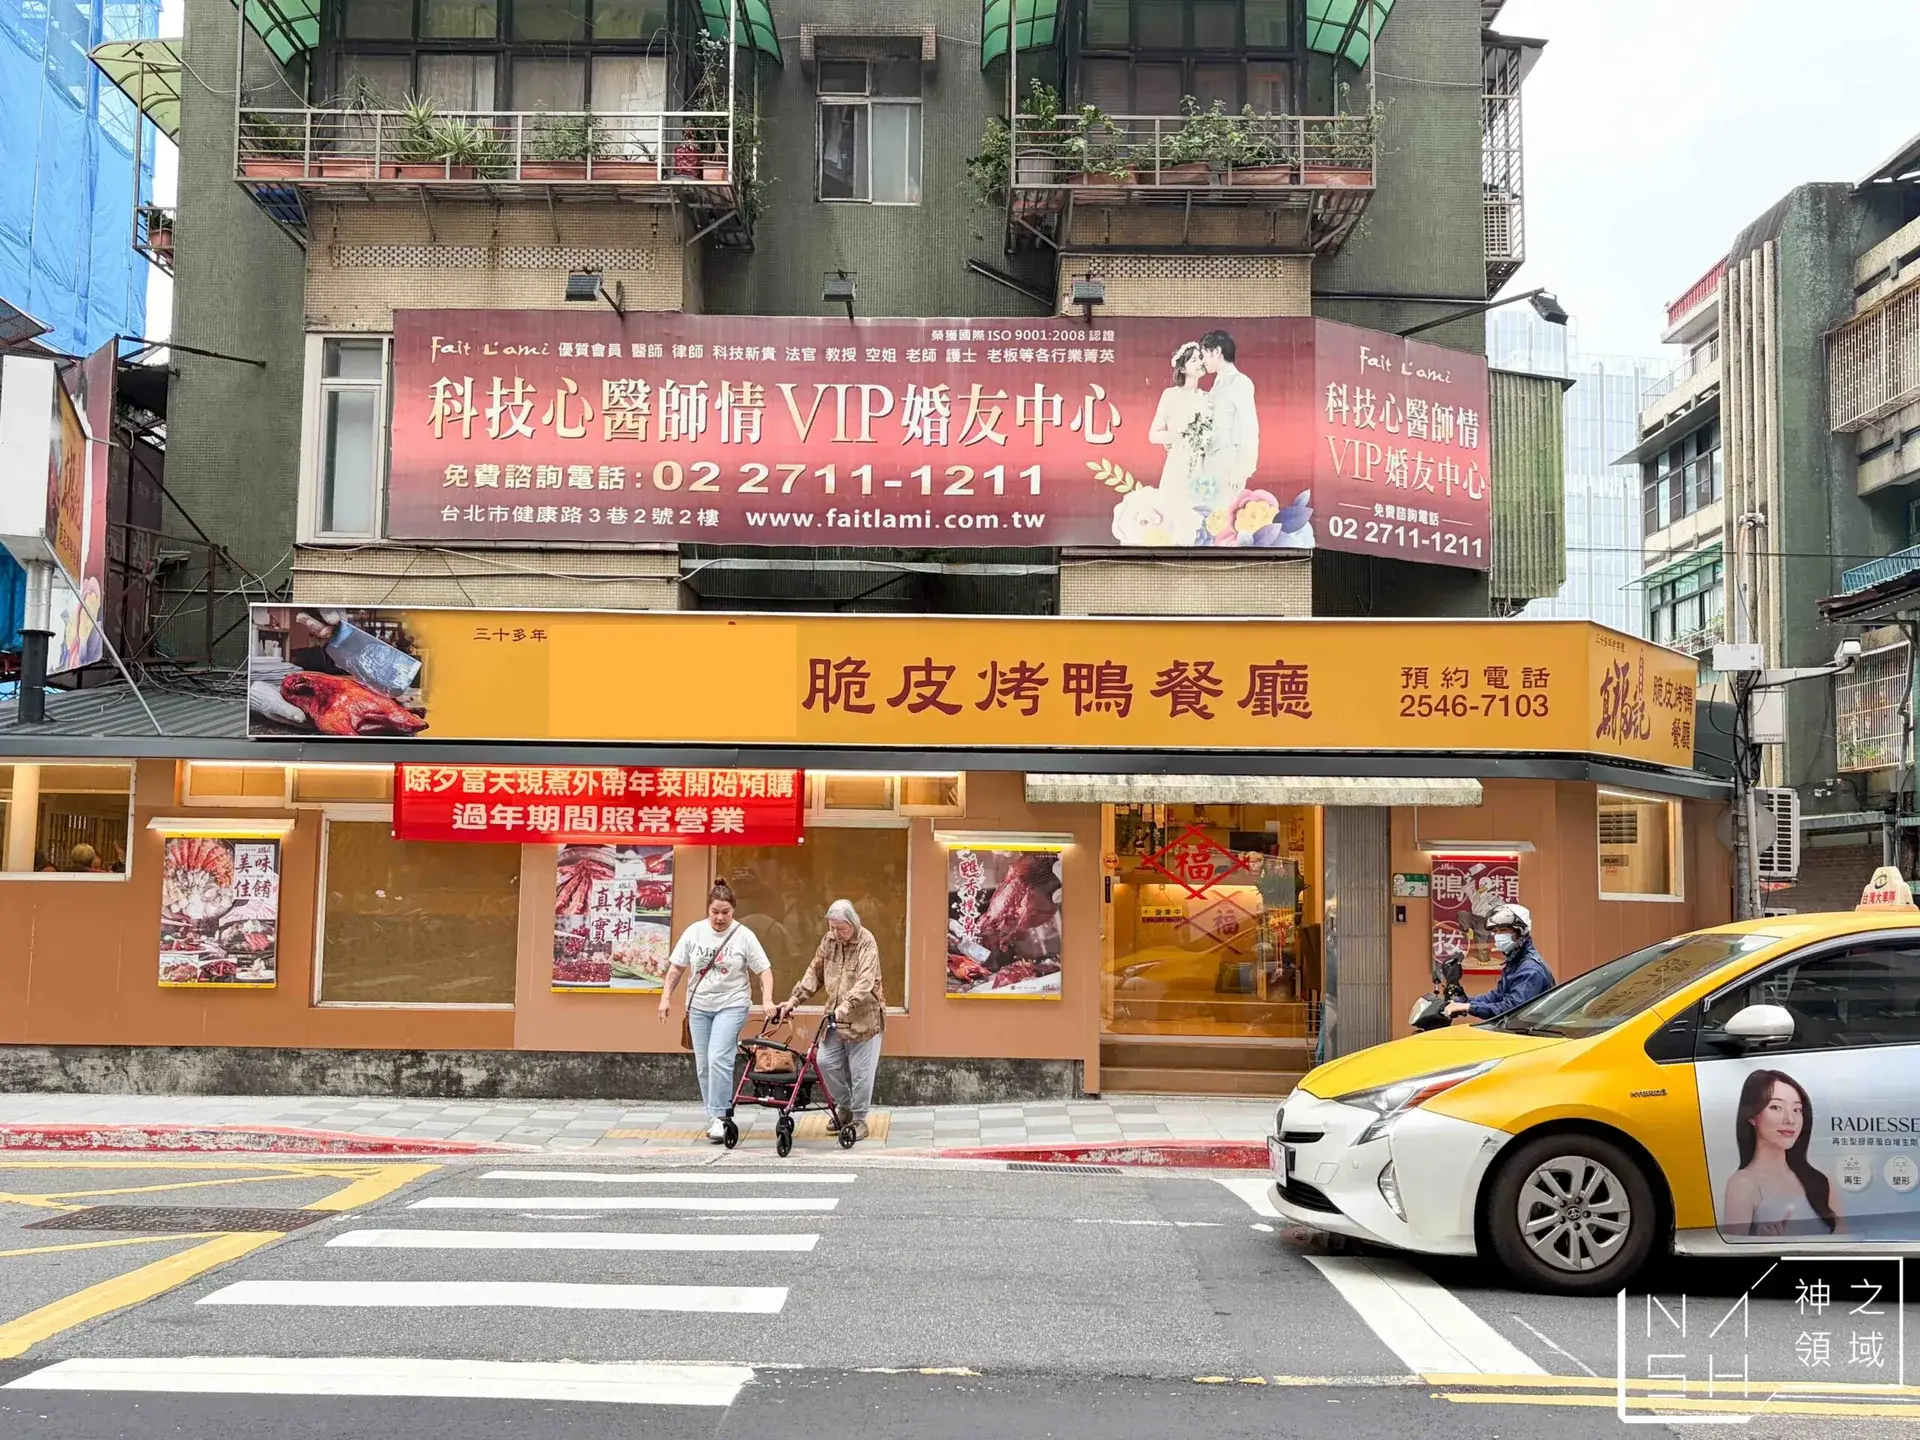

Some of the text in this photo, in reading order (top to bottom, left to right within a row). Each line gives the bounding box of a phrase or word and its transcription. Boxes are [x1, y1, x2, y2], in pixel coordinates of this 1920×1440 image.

[931, 329, 1115, 342] 榮獲國際 ISO 9001:2008 認證
[431, 336, 471, 363] Fait
[558, 342, 1115, 364] 優質會員 醫師 律師 科技新貴 法官 教授 空姐 老師 護士 老板等各行業菁英
[1359, 345, 1392, 375] Fait
[1325, 381, 1480, 450] 科技心醫師情
[652, 460, 721, 492] 02
[737, 463, 1042, 496] 2711-1211
[1325, 435, 1486, 501] VIP婚友中心
[440, 505, 720, 527] 台北市健康路3巷2號2樓
[746, 508, 1046, 529] www.faitlami.com.tw
[1373, 502, 1440, 527] 免費諮詢電話
[1329, 515, 1483, 559] 02 2711-1211
[473, 628, 548, 642] 三十多年
[802, 656, 1313, 720] 脆皮烤鴨餐廳
[1400, 666, 1551, 689] 預約電話
[1400, 694, 1549, 718] 2546-7103
[1653, 674, 1693, 715] 脆皮烤鴨
[1672, 717, 1691, 750] 餐廳
[404, 768, 793, 798] 除夕當天現煮外帶年菜開始預購
[452, 803, 745, 834] 過年期間照常營業
[235, 853, 273, 873] 美味
[1174, 844, 1215, 881] 福
[234, 879, 272, 899] 佳餚
[591, 887, 638, 913] 真材
[592, 918, 634, 944] 實料
[1831, 1116, 1920, 1132] RADIESSE
[1844, 1175, 1862, 1185] 再生
